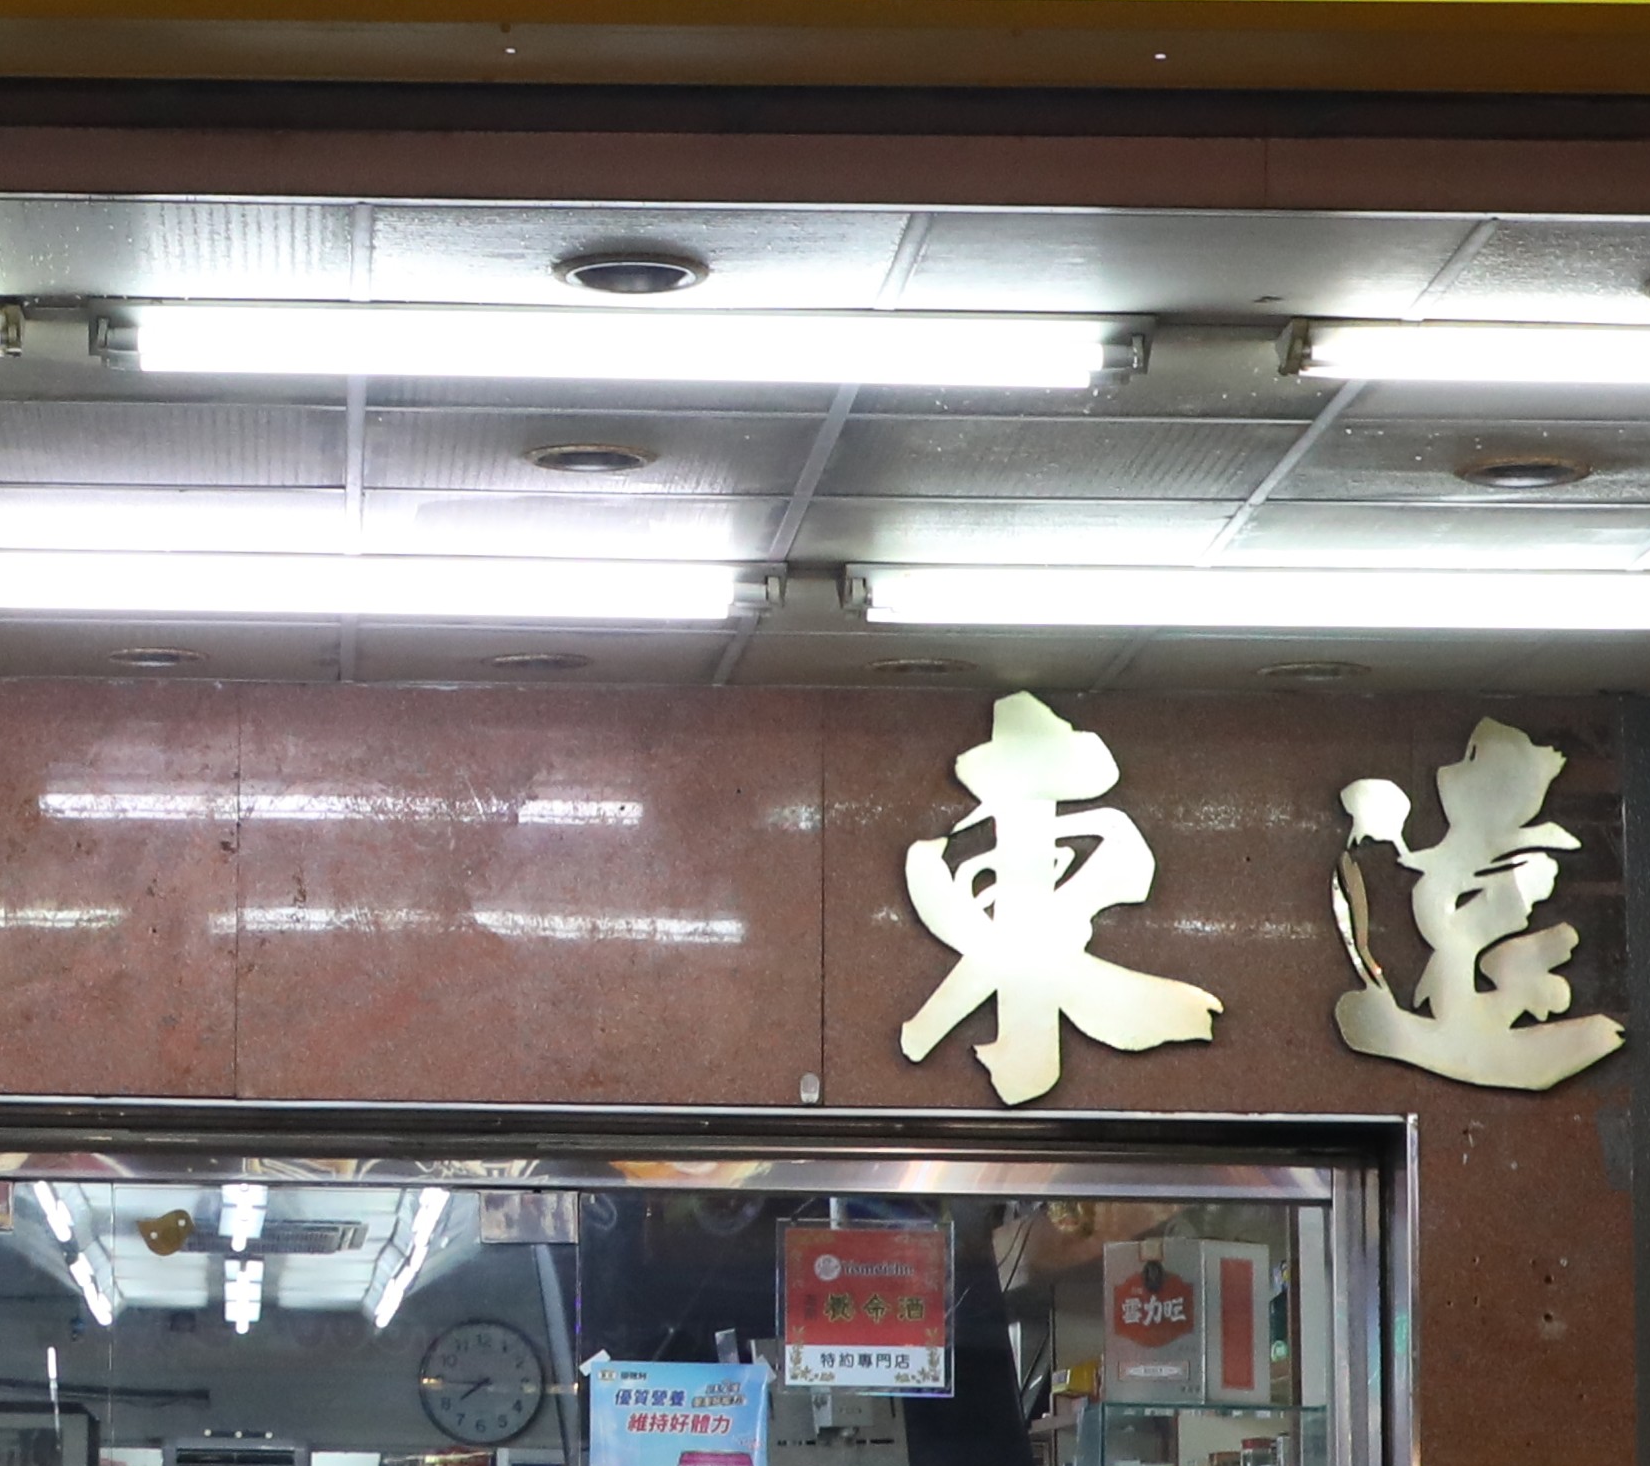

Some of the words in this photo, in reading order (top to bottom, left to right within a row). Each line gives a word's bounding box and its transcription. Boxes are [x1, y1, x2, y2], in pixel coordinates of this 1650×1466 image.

[823, 1294, 926, 1324] 養命酒
[820, 1352, 910, 1369] 特約專門店
[615, 1389, 686, 1407] 優質營養
[628, 1414, 732, 1434] 維持好體力
